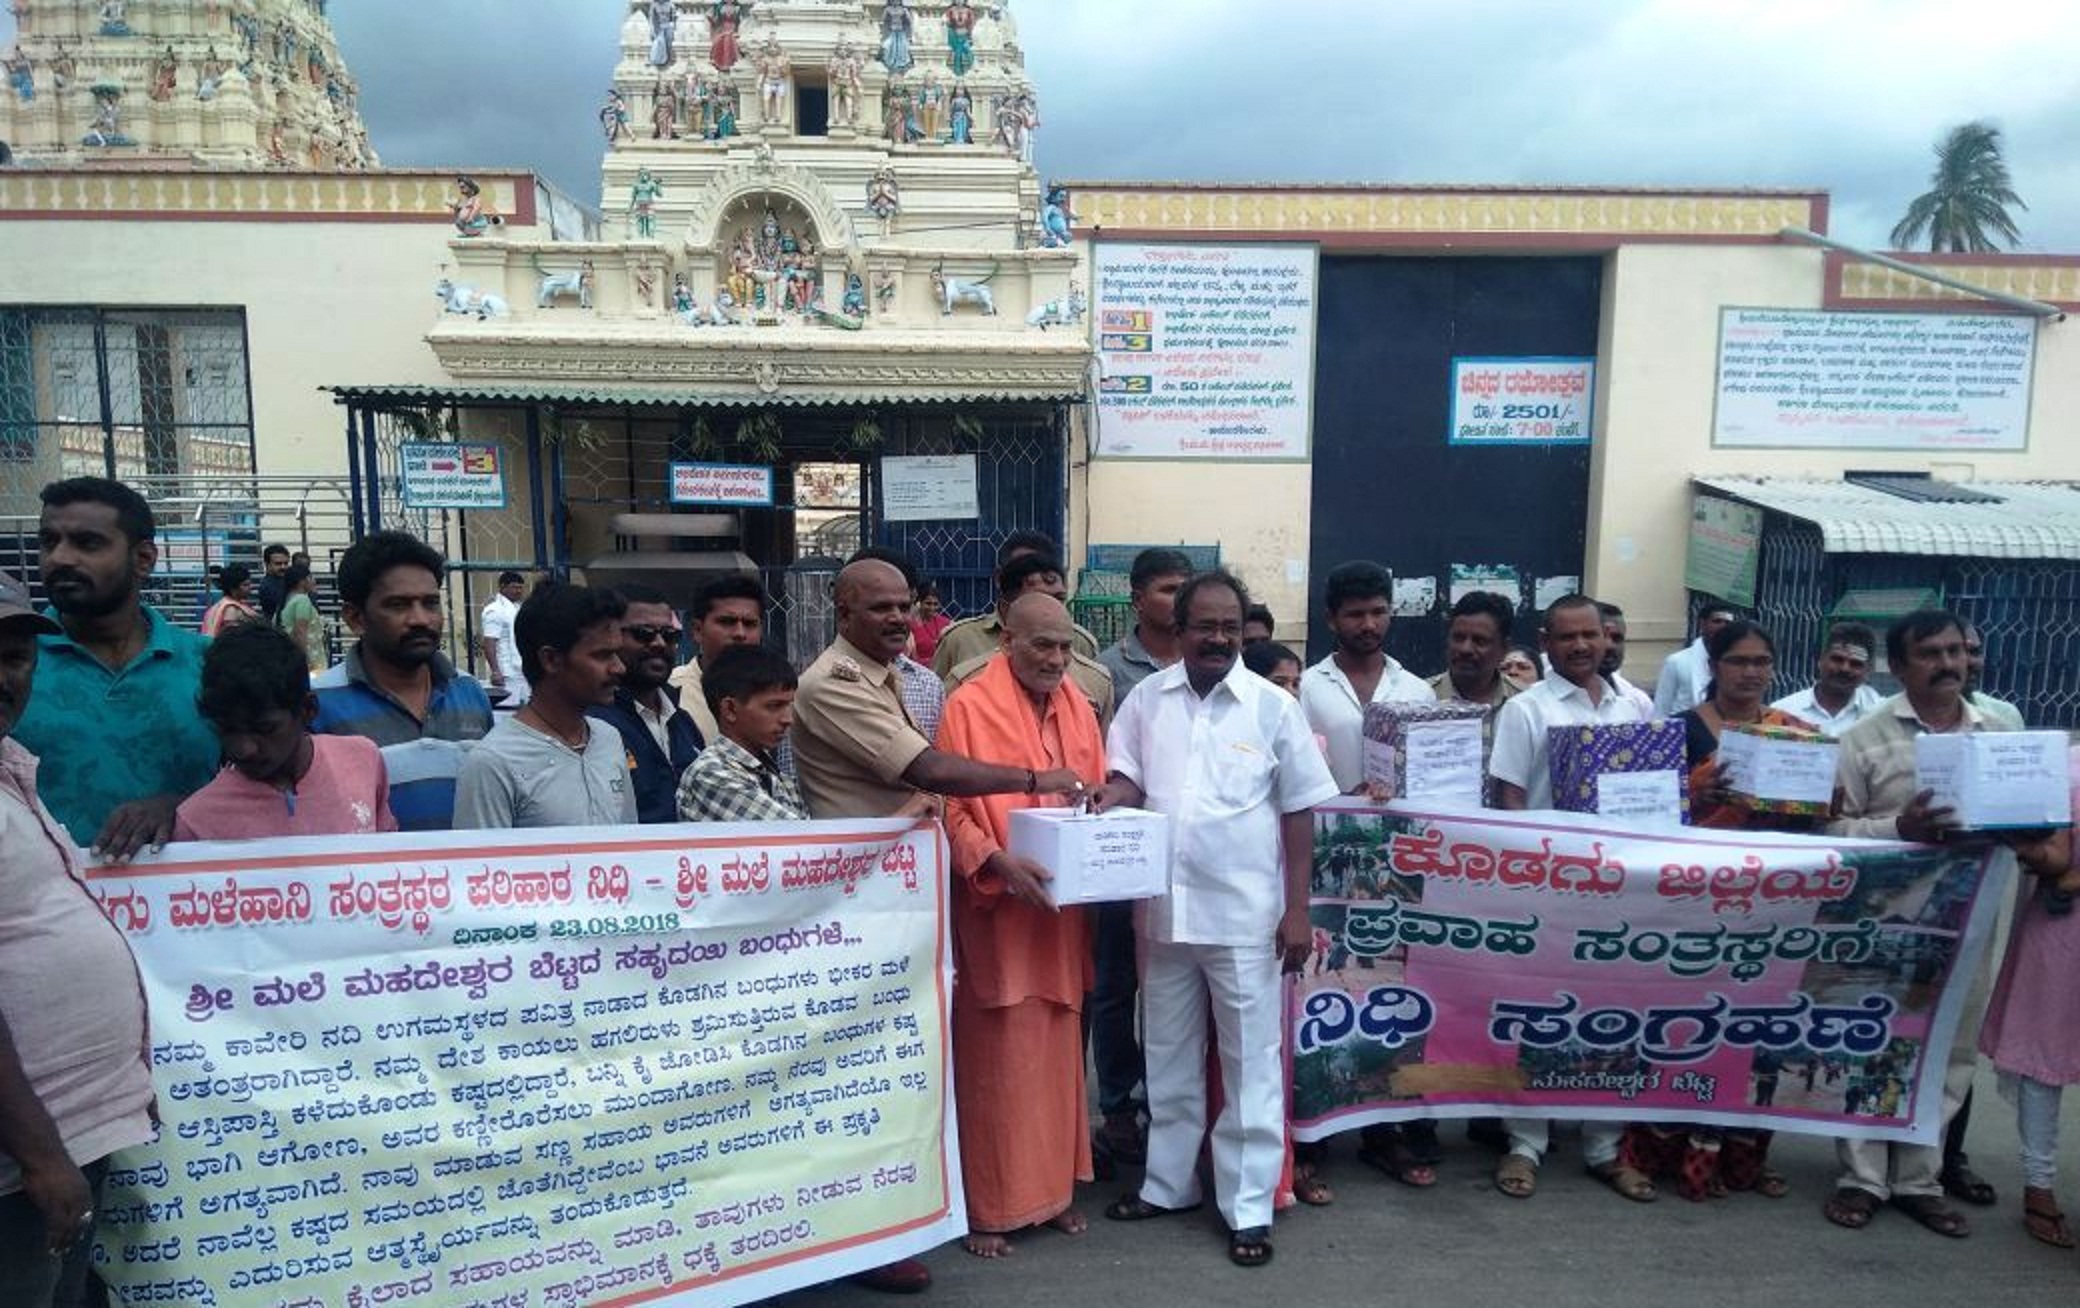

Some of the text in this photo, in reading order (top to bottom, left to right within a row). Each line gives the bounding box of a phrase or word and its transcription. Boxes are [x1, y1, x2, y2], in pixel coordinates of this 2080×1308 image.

[169, 877, 311, 928] ಮಳೆಹಾನಿ
[466, 860, 573, 907] ಪರಿಹಾರ
[588, 864, 629, 904] ನಿಧಿ
[676, 856, 708, 908] ಶ್ರೀ
[722, 852, 769, 892] ಮಲೆ
[1390, 829, 1857, 915] ಕೊಡಗು ಜಿಲ್ಲೆಯ
[453, 912, 681, 945] ದಿನಾಂಕ 23.08.2018
[1347, 899, 1878, 982] ಪ್ರವಾಹ ಸಂತ್ರಸ್ಥರಿಗೆ
[153, 1040, 216, 1073] ನಮ್ಮ
[226, 1031, 307, 1057] ಕಾವೇರಿ
[321, 1025, 361, 1049] ನದಿ
[520, 1000, 575, 1028] ಪವಿತ್ರ
[658, 981, 727, 1006] ಕೊಡಗಿನ
[737, 969, 819, 995] ಬಂಧುಗಳು
[828, 963, 873, 986] ಭೀಕರ
[881, 956, 910, 976] ಮಳೆ
[185, 983, 234, 1022] ಶ್ರೀ
[253, 971, 327, 1007] ಮಲೆ
[343, 954, 514, 1000] ಮಹದೇಶ್ವರ
[529, 947, 602, 991] ಬೆಟ್ಟದ
[1299, 986, 1895, 1062] ನಿಧಿ ಸಂಗ್ರಹಣೆ
[374, 1053, 428, 1084] ನಮ್ಮ
[437, 1044, 486, 1069] ದೇಶ
[498, 1036, 578, 1060] ಕಾಯಲು
[591, 1018, 681, 1049] ಹಗಲಿರುಳು
[805, 993, 858, 1017] ಕೊಡವ
[108, 1159, 169, 1189] ನಾವು
[186, 1151, 243, 1182] ಭಾಗಿ
[381, 1121, 441, 1149] ಅವರ
[745, 1066, 779, 1092] ನಮ್ಮ
[836, 1045, 888, 1068] ಅವರಿಗೆ
[895, 1040, 926, 1059] ಈಗ
[178, 1109, 279, 1147] ಆಸ್ತಿಪಾಸ್ತಿ
[291, 1087, 437, 1124] ಕಳೆದುಕೊಂಡು
[587, 1060, 627, 1088] ಬನ್ನಿ
[632, 1055, 653, 1085] ಕೈ
[659, 1045, 732, 1071] ಜೋಡಿಸಿ
[741, 1032, 807, 1057] ಕೊಡಗಿನ
[823, 1018, 886, 1044] ಬಂಧುಗಳ
[361, 1162, 419, 1191] ನಾವು
[433, 1145, 523, 1177] ಮಾಡುವ
[535, 1139, 574, 1167] ಸಣ್ಣ
[583, 1121, 653, 1151] ಸಹಾಯ
[663, 1101, 751, 1134] ಅವರುಗಳಿಗೆ
[899, 1070, 928, 1092] ಇಲ್ಲ
[197, 1224, 279, 1255] ನಾವೆಲ್ಲ
[291, 1209, 349, 1246] ಕಷ್ಟದ
[363, 1185, 486, 1226] ಸಮಯದಲ್ಲಿ
[655, 1140, 709, 1172] ಭಾವನೆ
[717, 1119, 805, 1154] ಅವರುಗಳಿಗೆ
[815, 1118, 833, 1135] ಈ
[842, 1107, 881, 1136] ಪ್ರಕೃತಿ
[230, 1248, 353, 1289] ಎದುರಿಸುವ
[346, 1271, 434, 1308] ಕೈಲಾದ
[450, 1237, 603, 1286] ಸಹಾಯವನ್ನು
[694, 1193, 785, 1229] ತಾವುಗಳು
[797, 1174, 863, 1207] ನೀಡುವ
[873, 1161, 918, 1188] ನೆರವು
[683, 1241, 721, 1273] ಧಕ್ಕೆ
